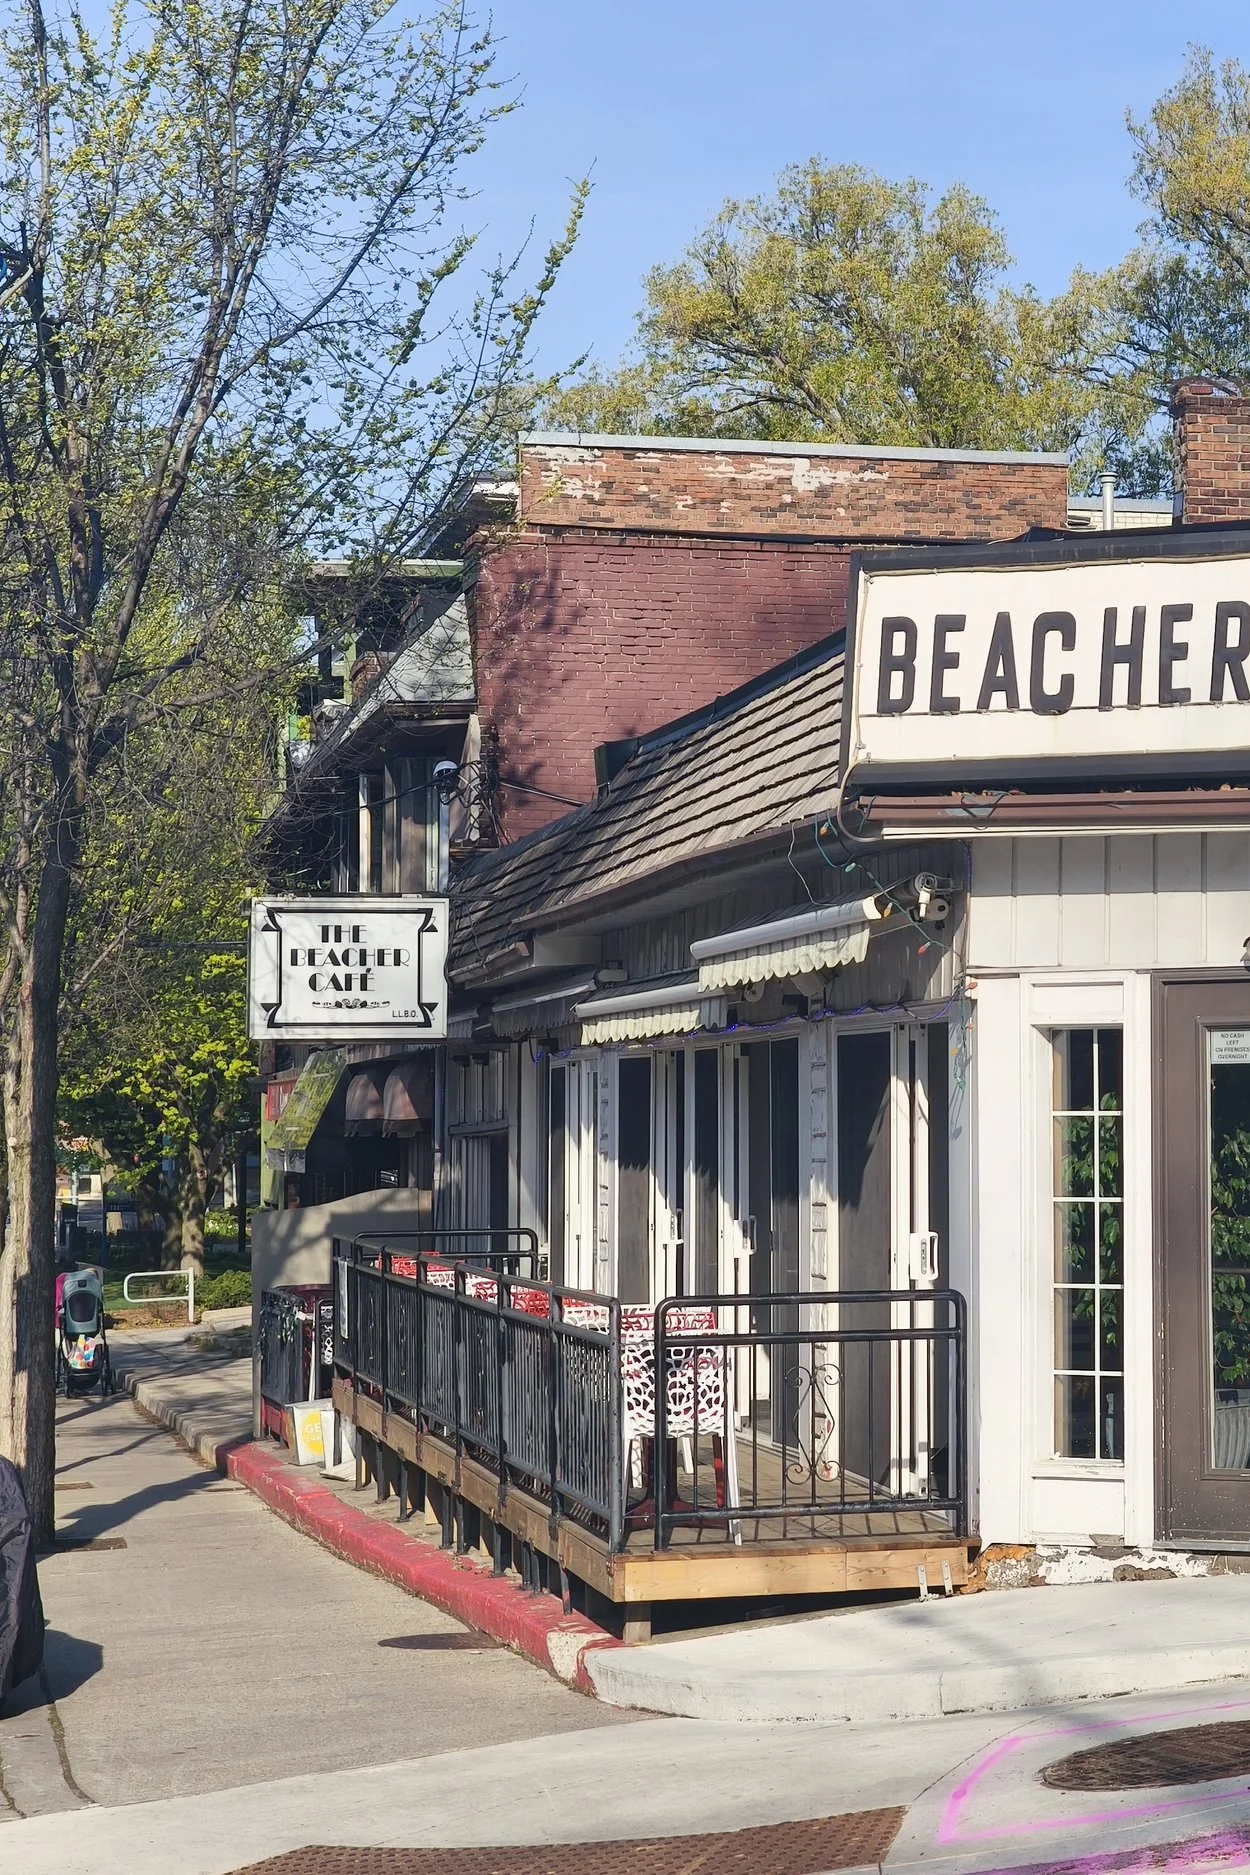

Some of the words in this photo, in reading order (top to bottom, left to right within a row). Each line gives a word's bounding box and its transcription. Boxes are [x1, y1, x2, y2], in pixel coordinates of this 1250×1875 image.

[317, 924, 368, 943] THE
[290, 947, 411, 967] BEACHER
[308, 967, 375, 992] CAFÉ
